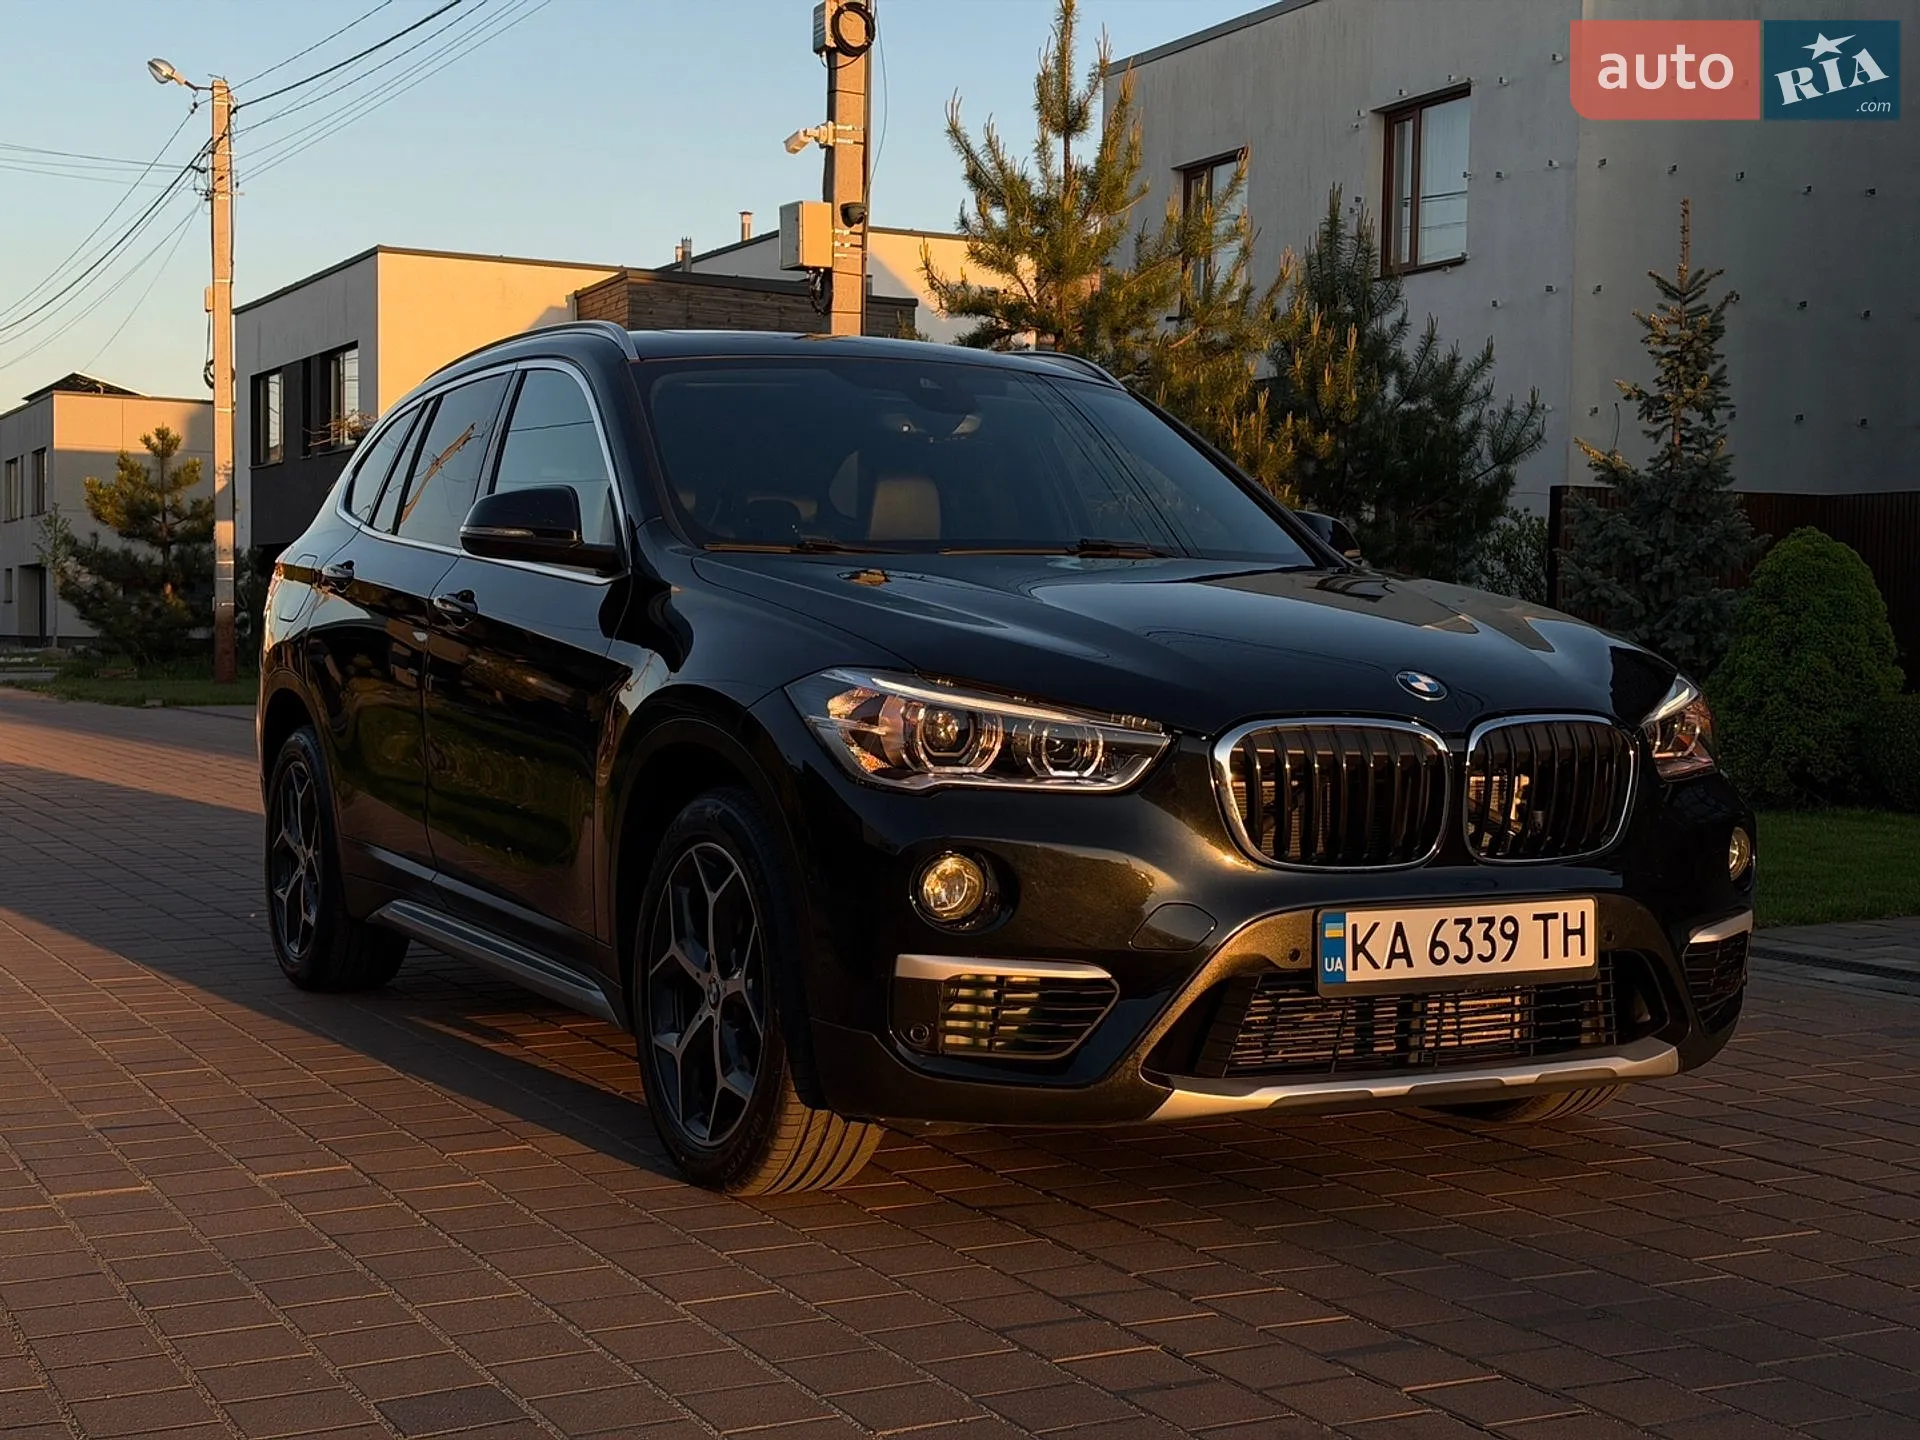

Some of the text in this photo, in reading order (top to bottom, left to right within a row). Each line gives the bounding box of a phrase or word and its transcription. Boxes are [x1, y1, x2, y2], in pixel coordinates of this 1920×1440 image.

[1351, 910, 1586, 971] KA 6339 TH
[1324, 957, 1344, 973] UA
